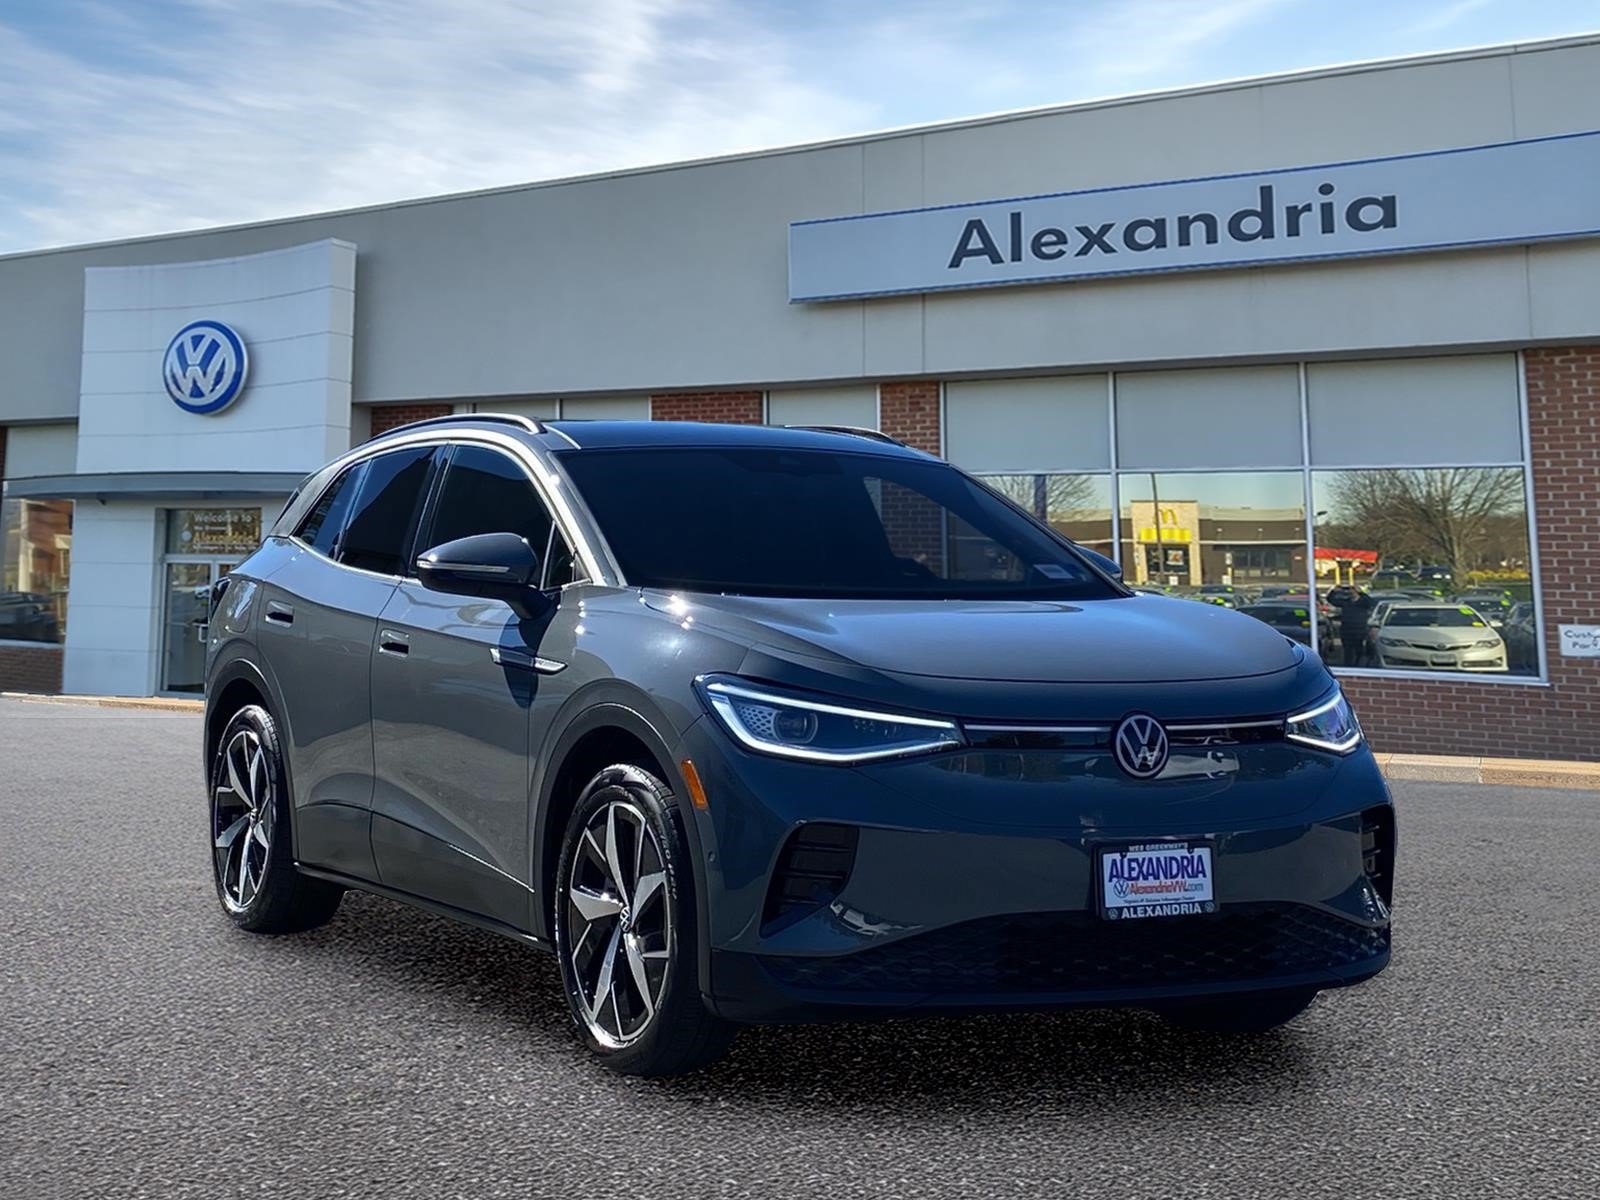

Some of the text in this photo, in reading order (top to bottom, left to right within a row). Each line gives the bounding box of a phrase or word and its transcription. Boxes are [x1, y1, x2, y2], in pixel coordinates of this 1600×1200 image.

[948, 182, 1399, 269] Alexandria
[164, 321, 246, 413] VW
[1108, 854, 1208, 882] ALEXANDRIA
[1121, 903, 1202, 919] ALEXANDRIA
